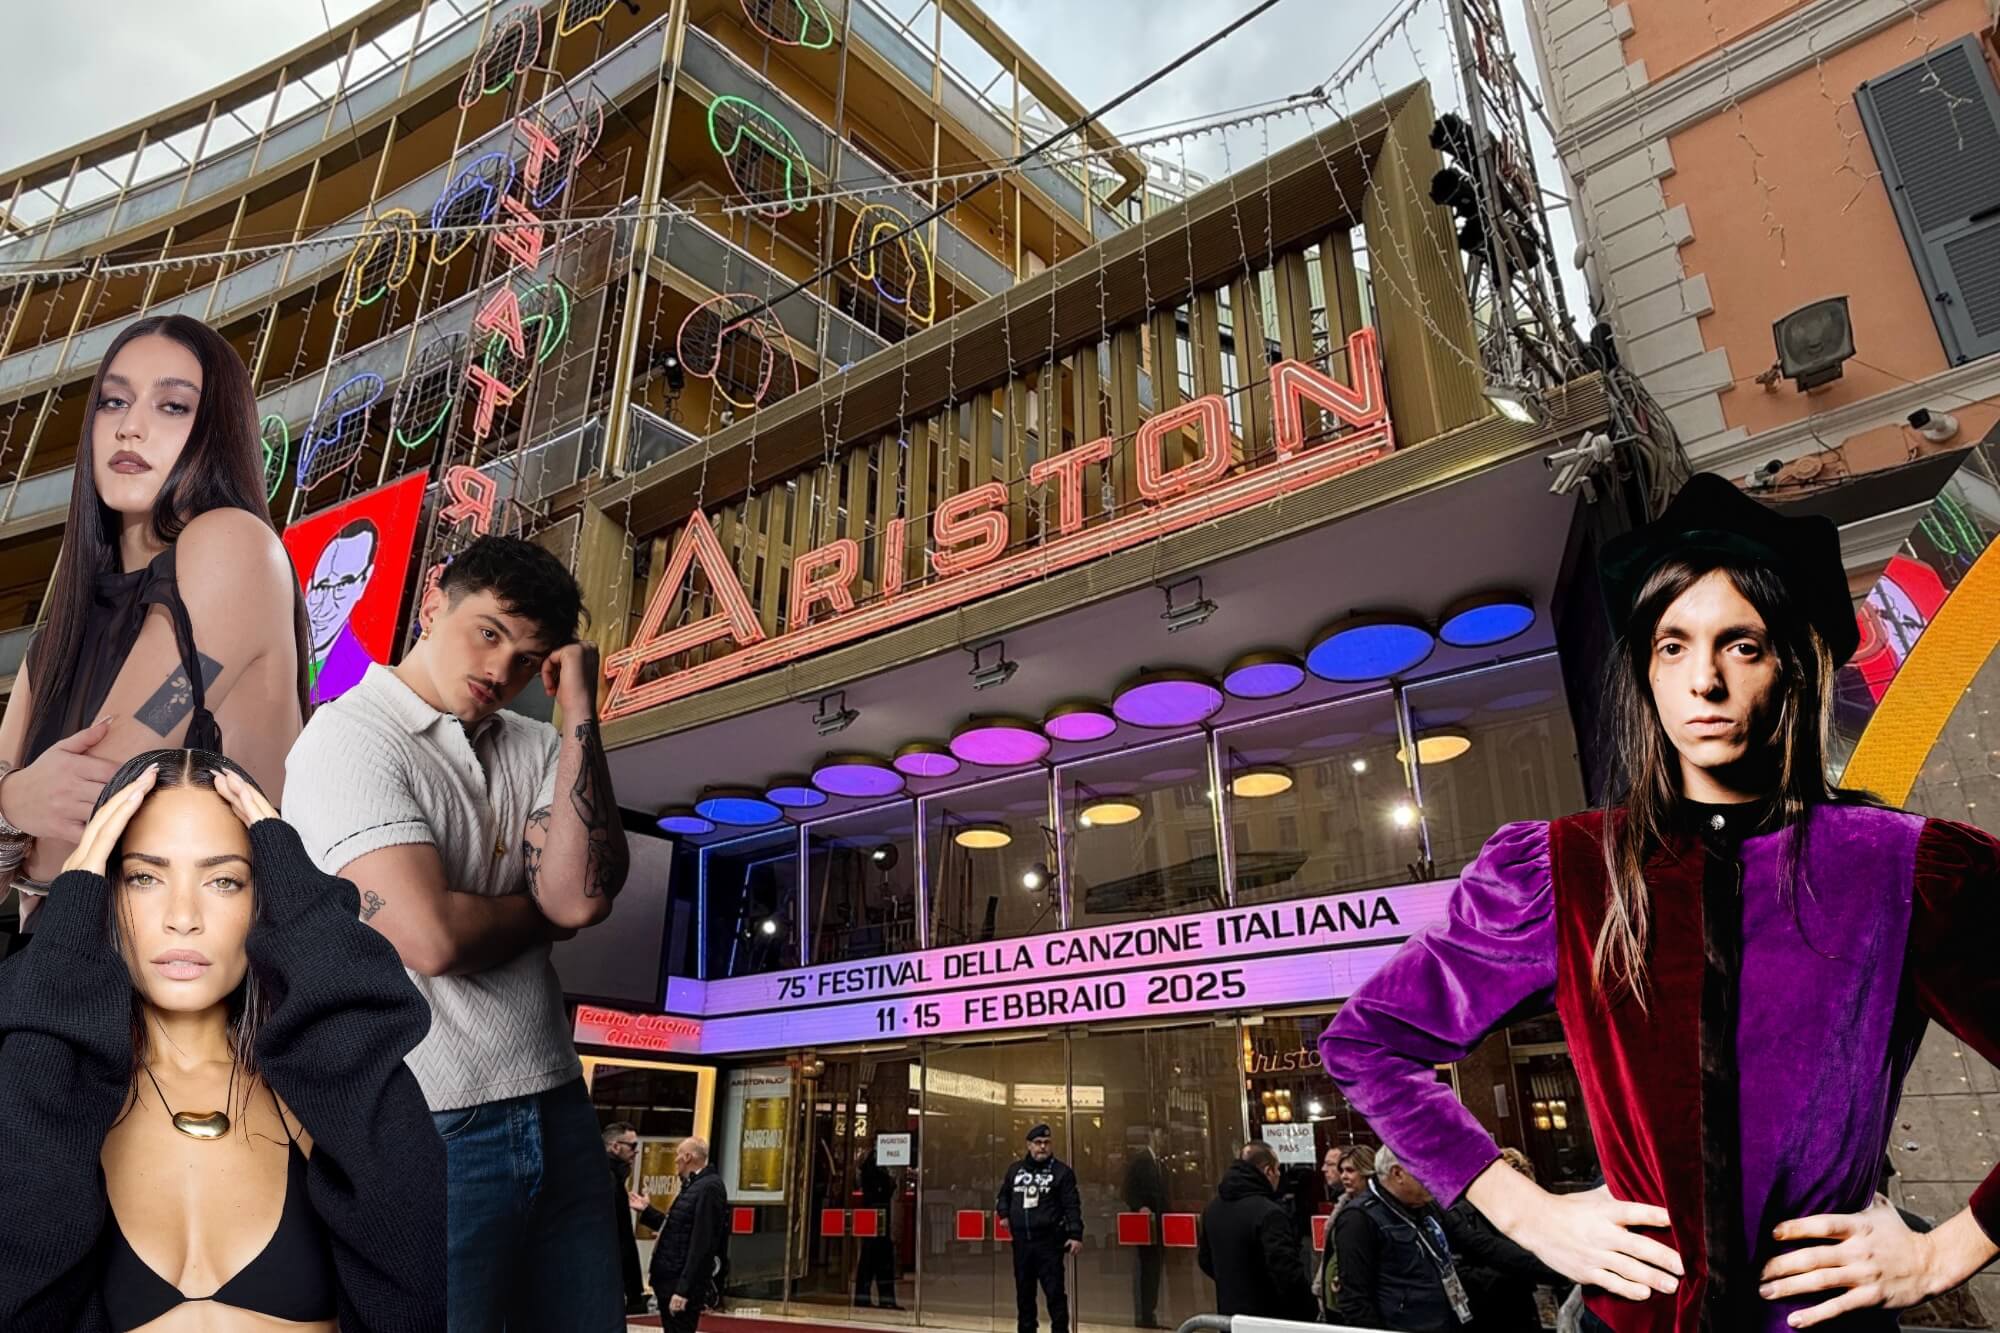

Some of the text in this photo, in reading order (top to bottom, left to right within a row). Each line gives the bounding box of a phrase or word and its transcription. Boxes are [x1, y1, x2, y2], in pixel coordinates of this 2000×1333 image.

[602, 327, 1393, 720] ARISTON
[817, 959, 932, 996] FESTIVAL
[943, 945, 1034, 980] DELLA
[1045, 922, 1203, 966] CANZONE
[1216, 896, 1401, 946] ITALIANA
[964, 981, 1126, 1025] FEBBRAIO
[1147, 969, 1247, 1005] 2025
